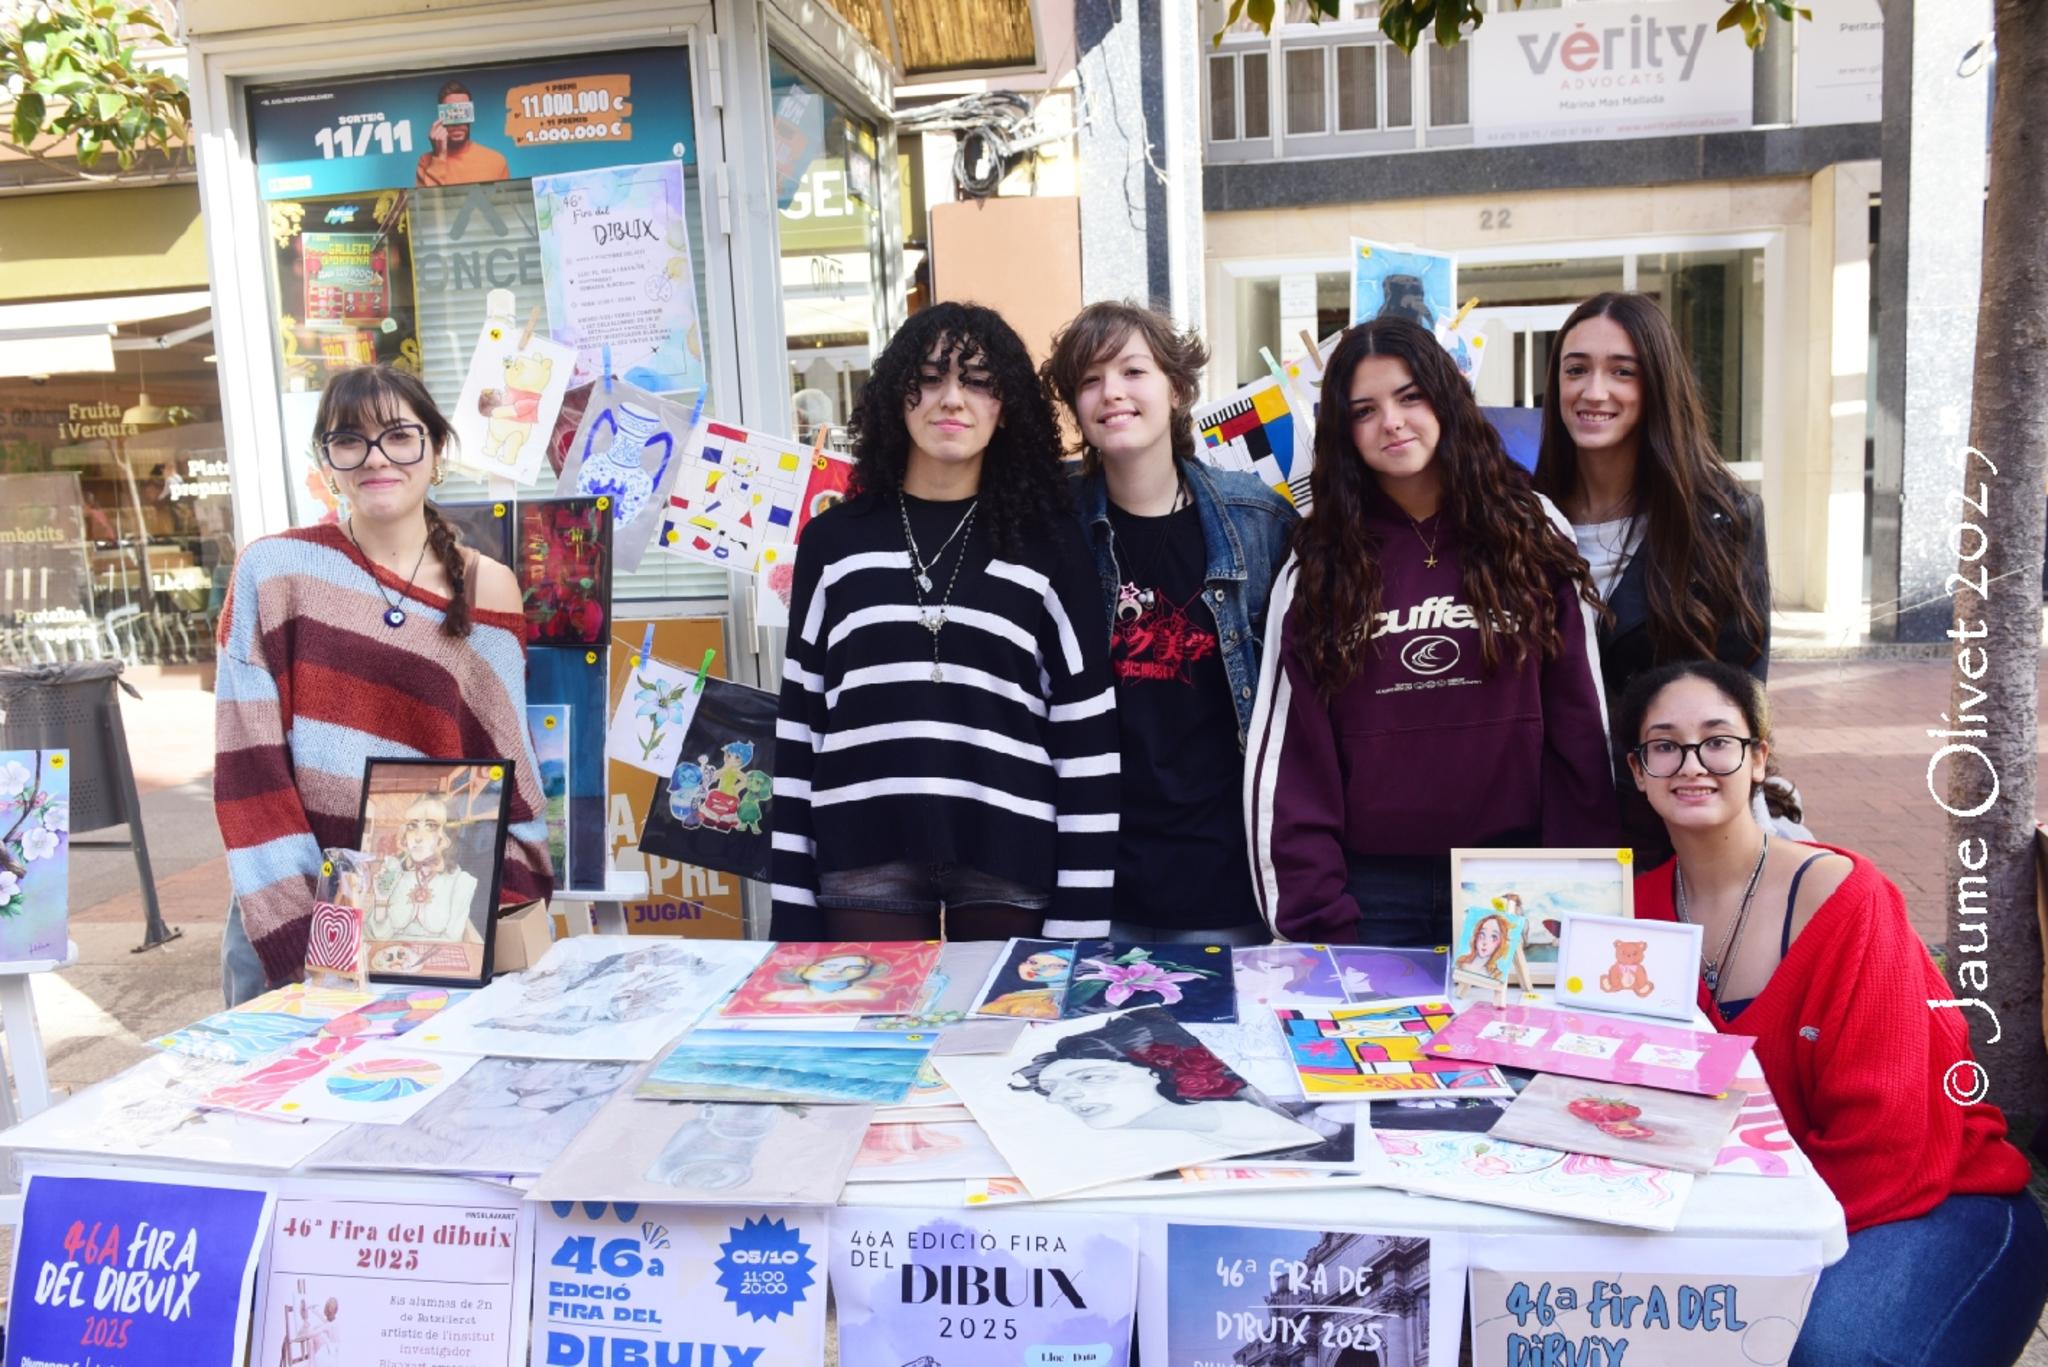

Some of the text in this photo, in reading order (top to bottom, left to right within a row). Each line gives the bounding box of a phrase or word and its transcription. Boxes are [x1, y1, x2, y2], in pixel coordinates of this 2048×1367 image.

[1560, 73, 1665, 91] ADVOCATS
[521, 89, 624, 118] 11.000.000 €
[1558, 99, 1596, 110] Marina
[1599, 97, 1619, 107] Mas
[338, 112, 385, 125] SORTEIG
[315, 119, 413, 160] 11/11
[526, 123, 608, 142] 1.000.000
[611, 122, 622, 136] €
[1480, 207, 1512, 231] 22
[419, 247, 543, 293] ONCE
[69, 401, 121, 420] Fruita
[59, 422, 139, 440] i Verdura
[170, 481, 232, 501] prepar
[634, 901, 705, 923] JUGAT
[329, 1219, 378, 1242] Fira
[388, 1224, 425, 1244] del
[433, 1224, 512, 1248] dibuix
[850, 1229, 1067, 1253] 46A EDICIÓ FIRA
[64, 1220, 198, 1273] 46A FIRA
[731, 1249, 800, 1265] 05/10
[356, 1247, 420, 1271] 2025
[850, 1250, 895, 1268] DEL
[743, 1270, 785, 1283] 11:00
[900, 1263, 1088, 1309] DIBUIX
[1268, 1257, 1328, 1296] FIRA
[1339, 1265, 1374, 1297] DE
[34, 1260, 201, 1322] DEL DIBUIX
[548, 1281, 631, 1301] EDICIÓ
[741, 1282, 788, 1295] 20:00
[460, 1299, 473, 1310] de
[476, 1299, 493, 1311] 2n
[548, 1301, 663, 1324] FIRA DEL
[1677, 1283, 1748, 1332] DEL
[399, 1311, 413, 1322] de
[81, 1315, 134, 1350] 2025
[425, 1329, 439, 1341] de
[938, 1316, 1018, 1340] 2025
[1215, 1311, 1385, 1352] DIBUIX 2025
[399, 1342, 472, 1359] investigador
[546, 1331, 767, 1367] DIBUIX
